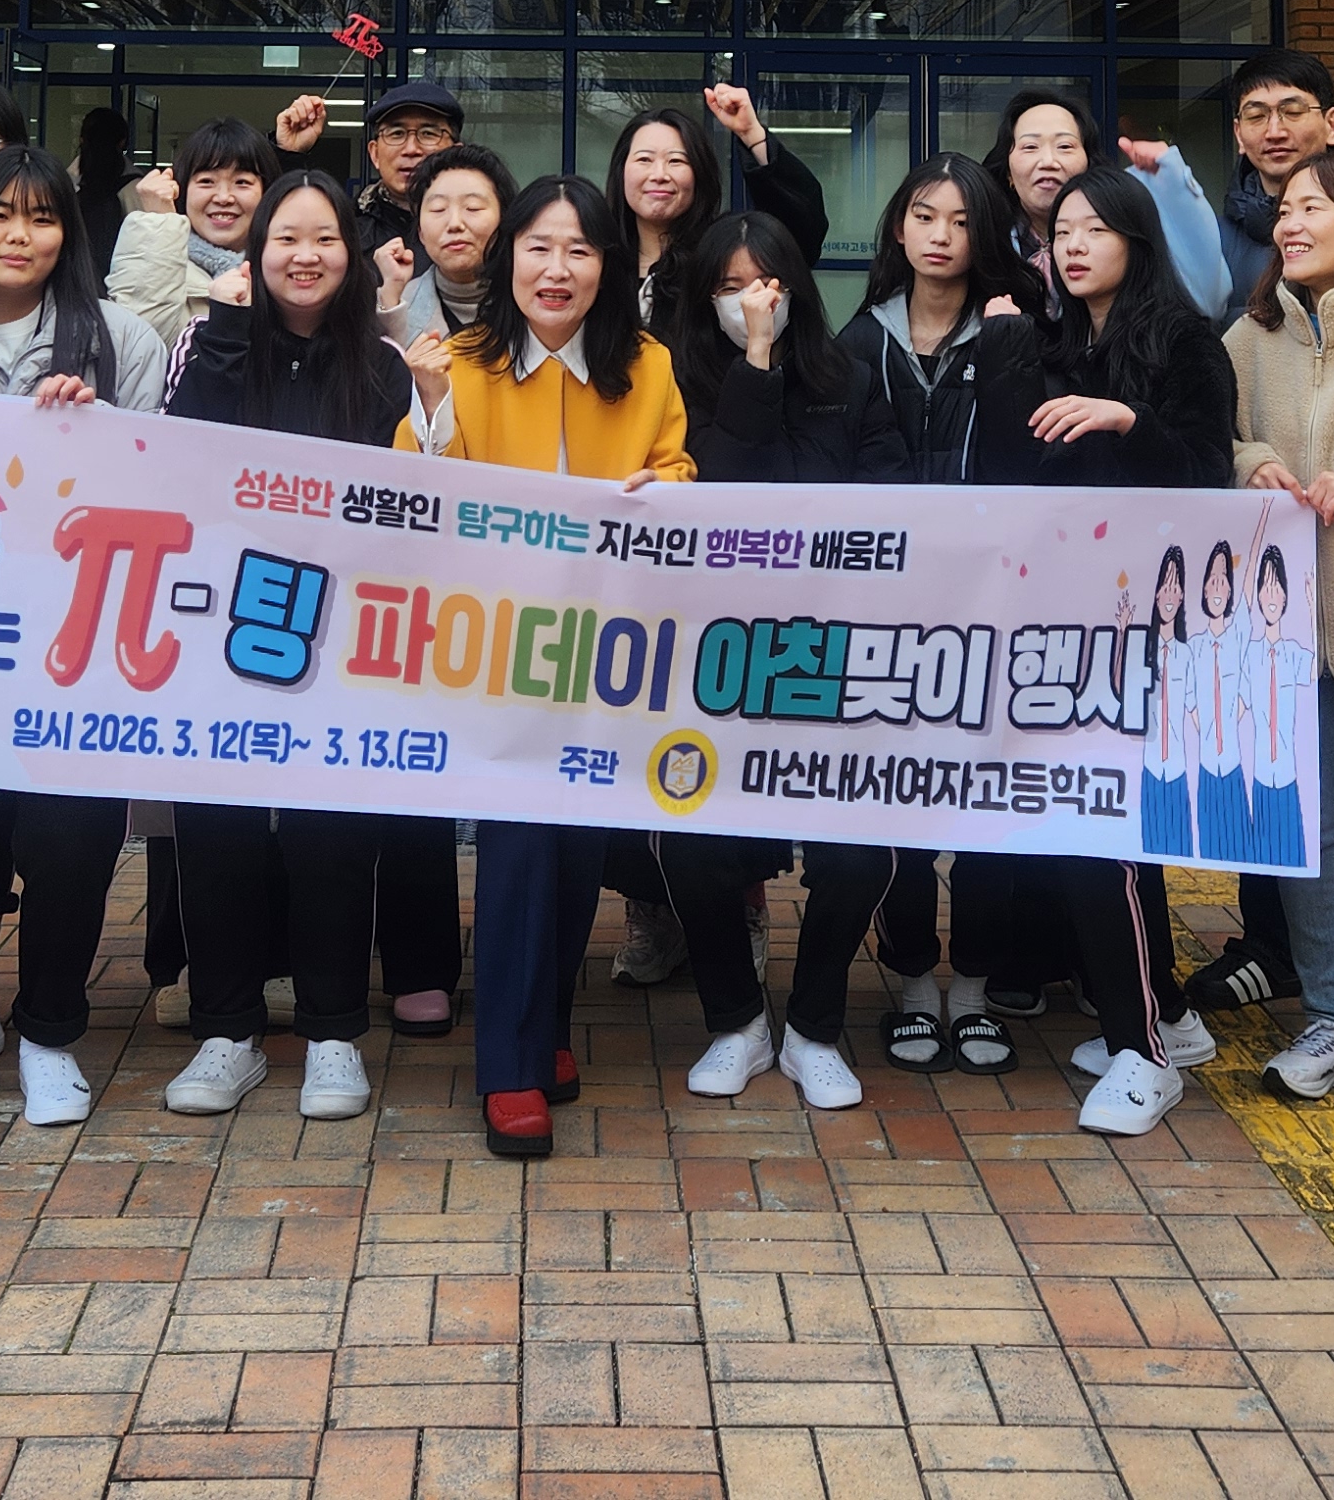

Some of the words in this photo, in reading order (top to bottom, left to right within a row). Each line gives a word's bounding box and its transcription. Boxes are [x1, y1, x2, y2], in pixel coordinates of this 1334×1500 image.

[233, 467, 336, 518] 성실한
[341, 483, 442, 533] 생활인
[457, 501, 591, 554] 탐구하는
[595, 520, 699, 567] 지식인
[705, 527, 806, 570] 행복한
[809, 530, 907, 572] 배움터
[346, 580, 677, 712] 파이데이
[693, 616, 995, 730] 아침맞이
[1007, 622, 1157, 737] 행사
[12, 707, 73, 751] 일시
[78, 712, 165, 756] 2026.
[172, 718, 199, 759] 3.
[323, 726, 350, 766] 3.
[558, 744, 620, 786] 주관
[741, 749, 1128, 818] 마산내서여자고등학교
[893, 1024, 932, 1039] PUMA
[958, 1025, 997, 1039] PUMA
